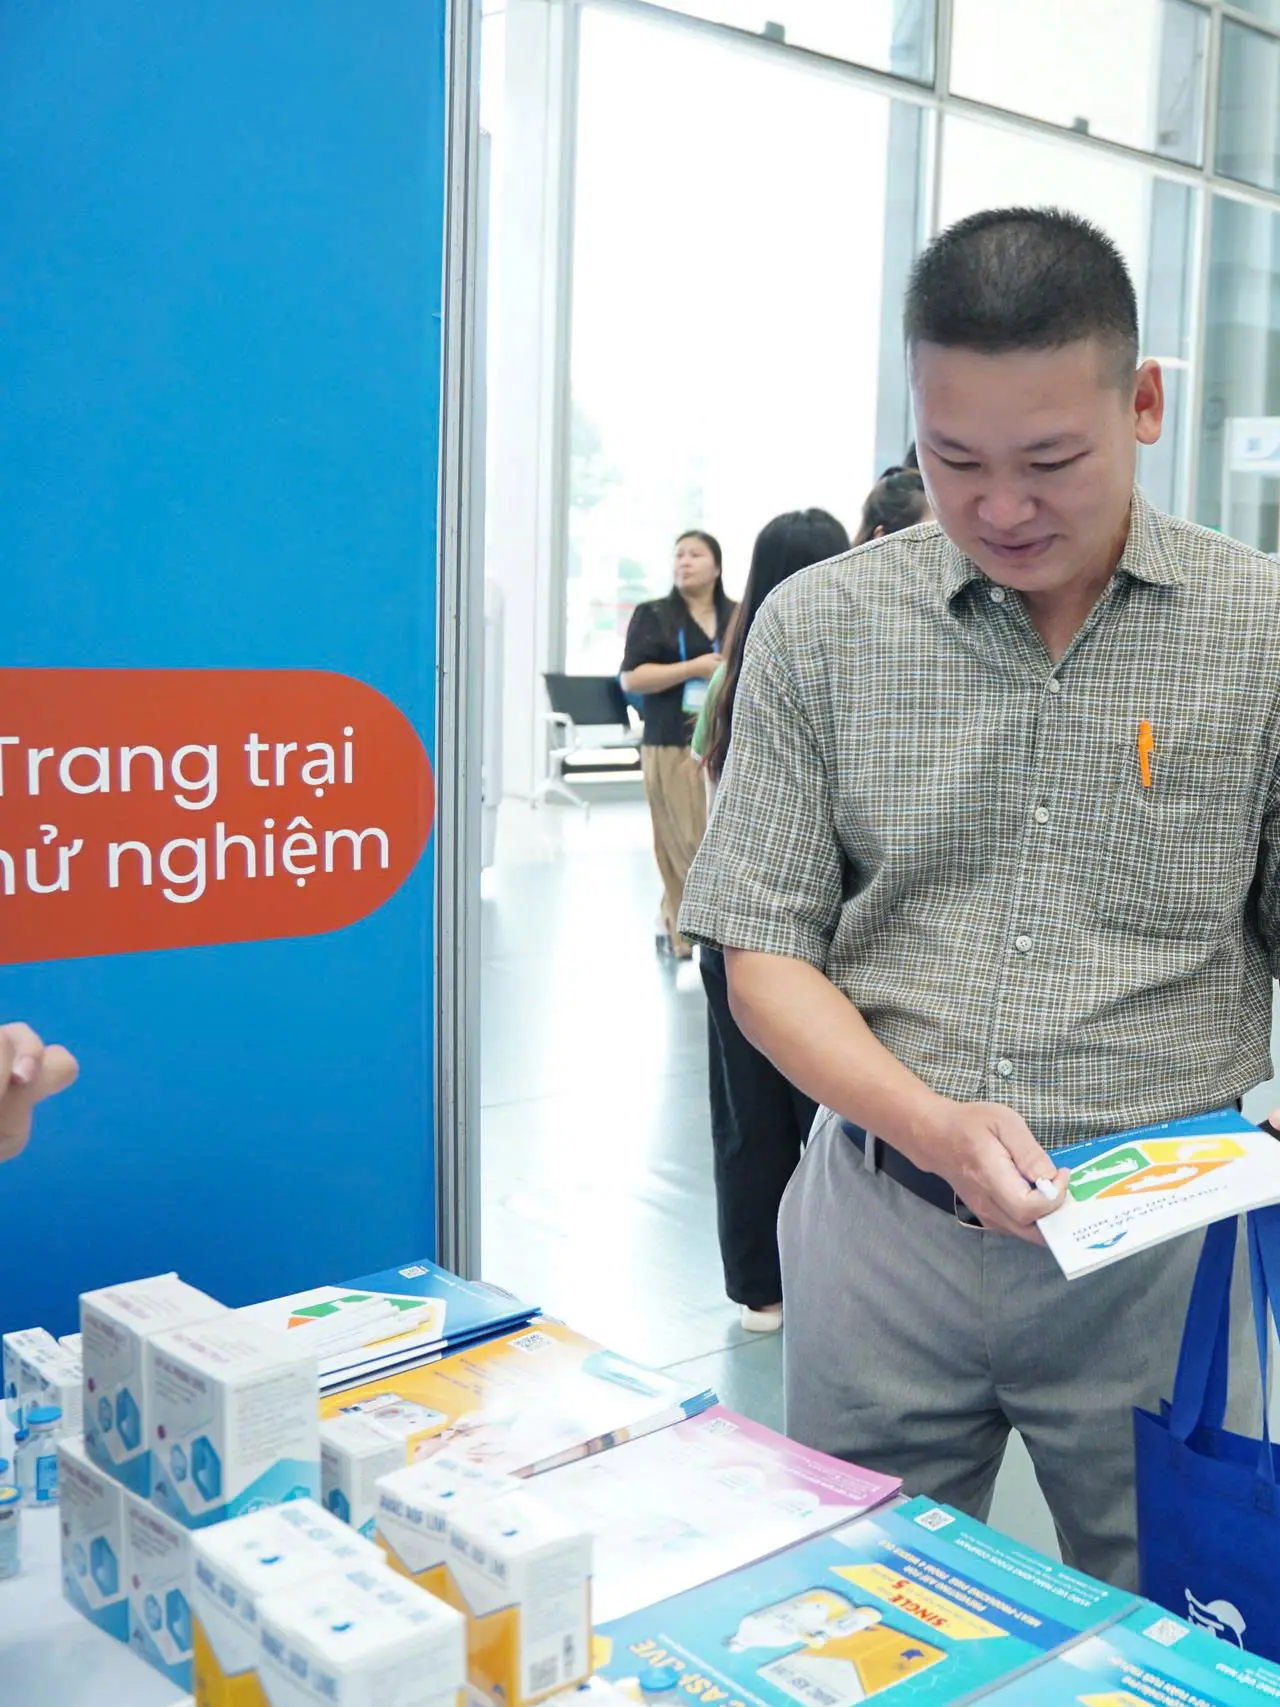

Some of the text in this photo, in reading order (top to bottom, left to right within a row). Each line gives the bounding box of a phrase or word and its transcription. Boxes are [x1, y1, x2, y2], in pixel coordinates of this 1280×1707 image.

[244, 726, 354, 798] trại
[108, 816, 390, 904] nghiệm
[888, 1593, 948, 1628] SINGLE
[892, 1579, 911, 1590] 5
